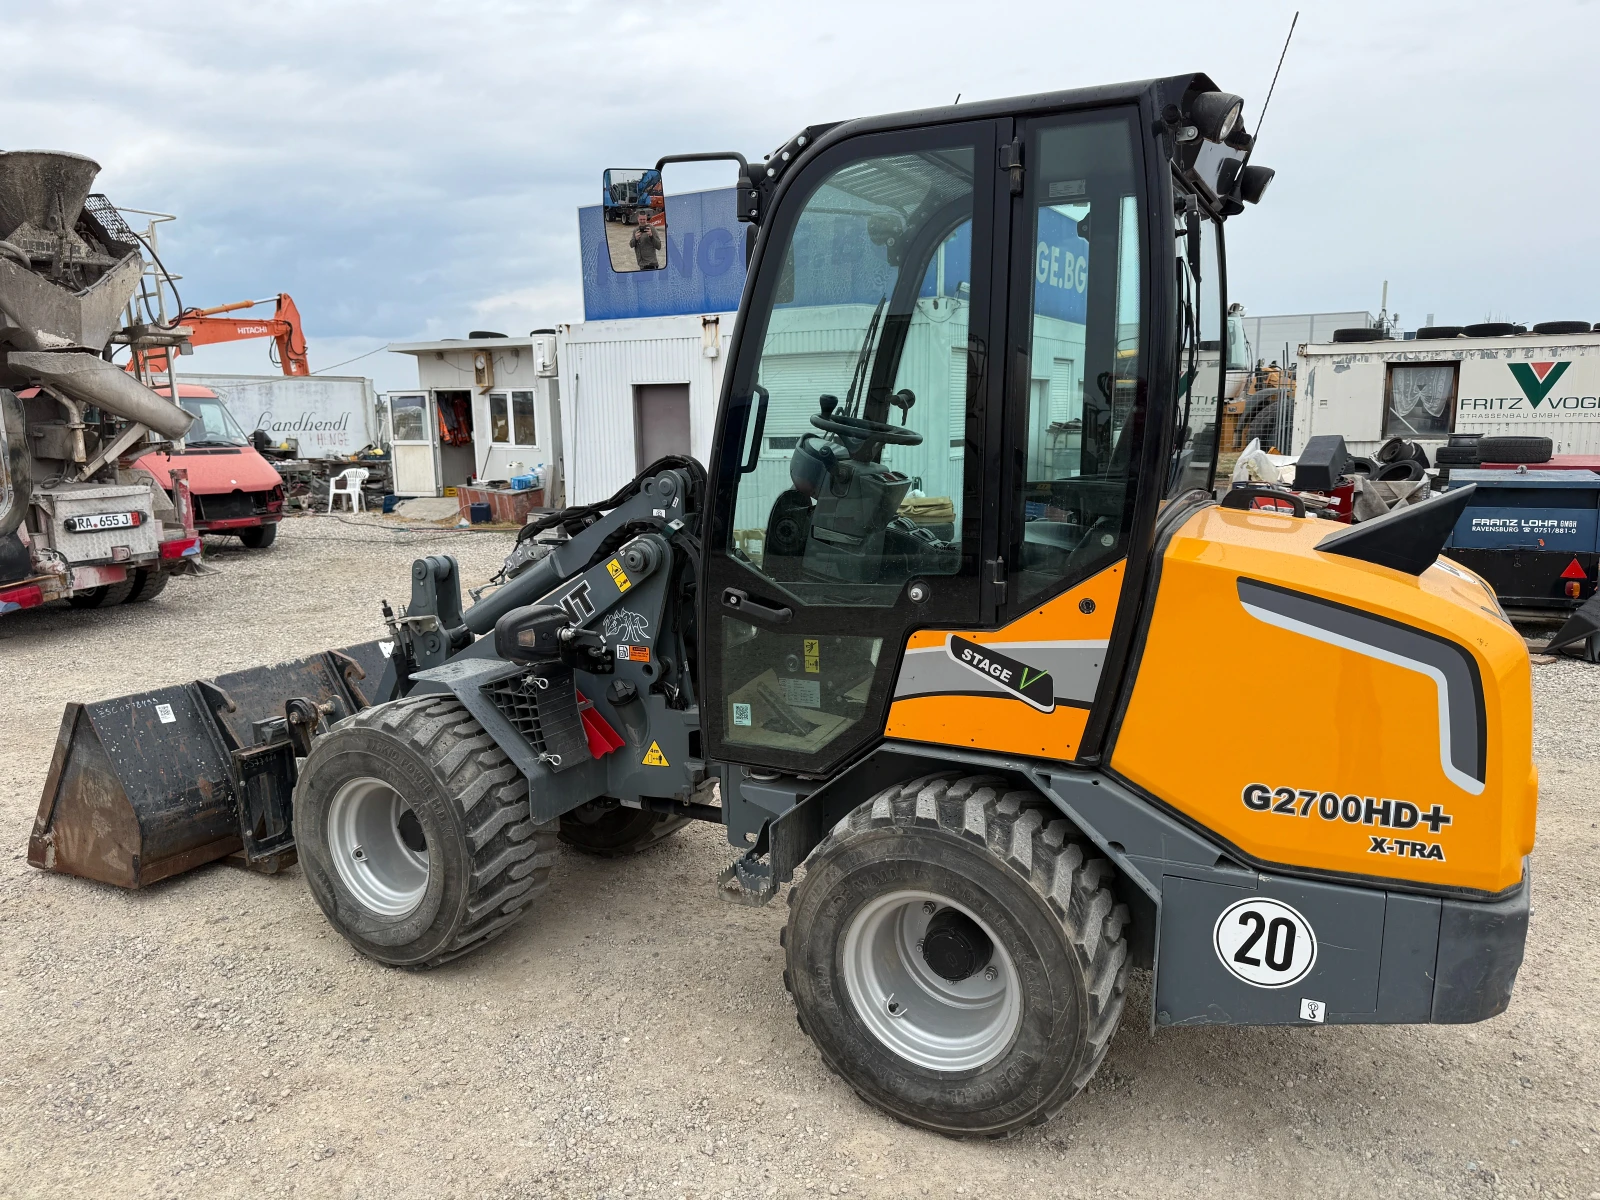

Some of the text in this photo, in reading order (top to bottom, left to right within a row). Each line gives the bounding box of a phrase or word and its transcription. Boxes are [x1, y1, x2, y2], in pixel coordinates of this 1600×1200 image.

[237, 326, 268, 334] HITACHI
[1460, 396, 1600, 410] FRITZ VOG
[256, 411, 351, 432] Landhendl
[77, 518, 93, 529] RA
[100, 515, 119, 527] 655
[122, 515, 129, 525] J
[1472, 518, 1518, 526] FRANZ
[1521, 519, 1558, 527] LOHR
[961, 648, 1013, 682] STAGE
[1242, 783, 1453, 834] G2700HD+
[1367, 835, 1446, 861] X-TRA
[1234, 911, 1297, 972] 20
